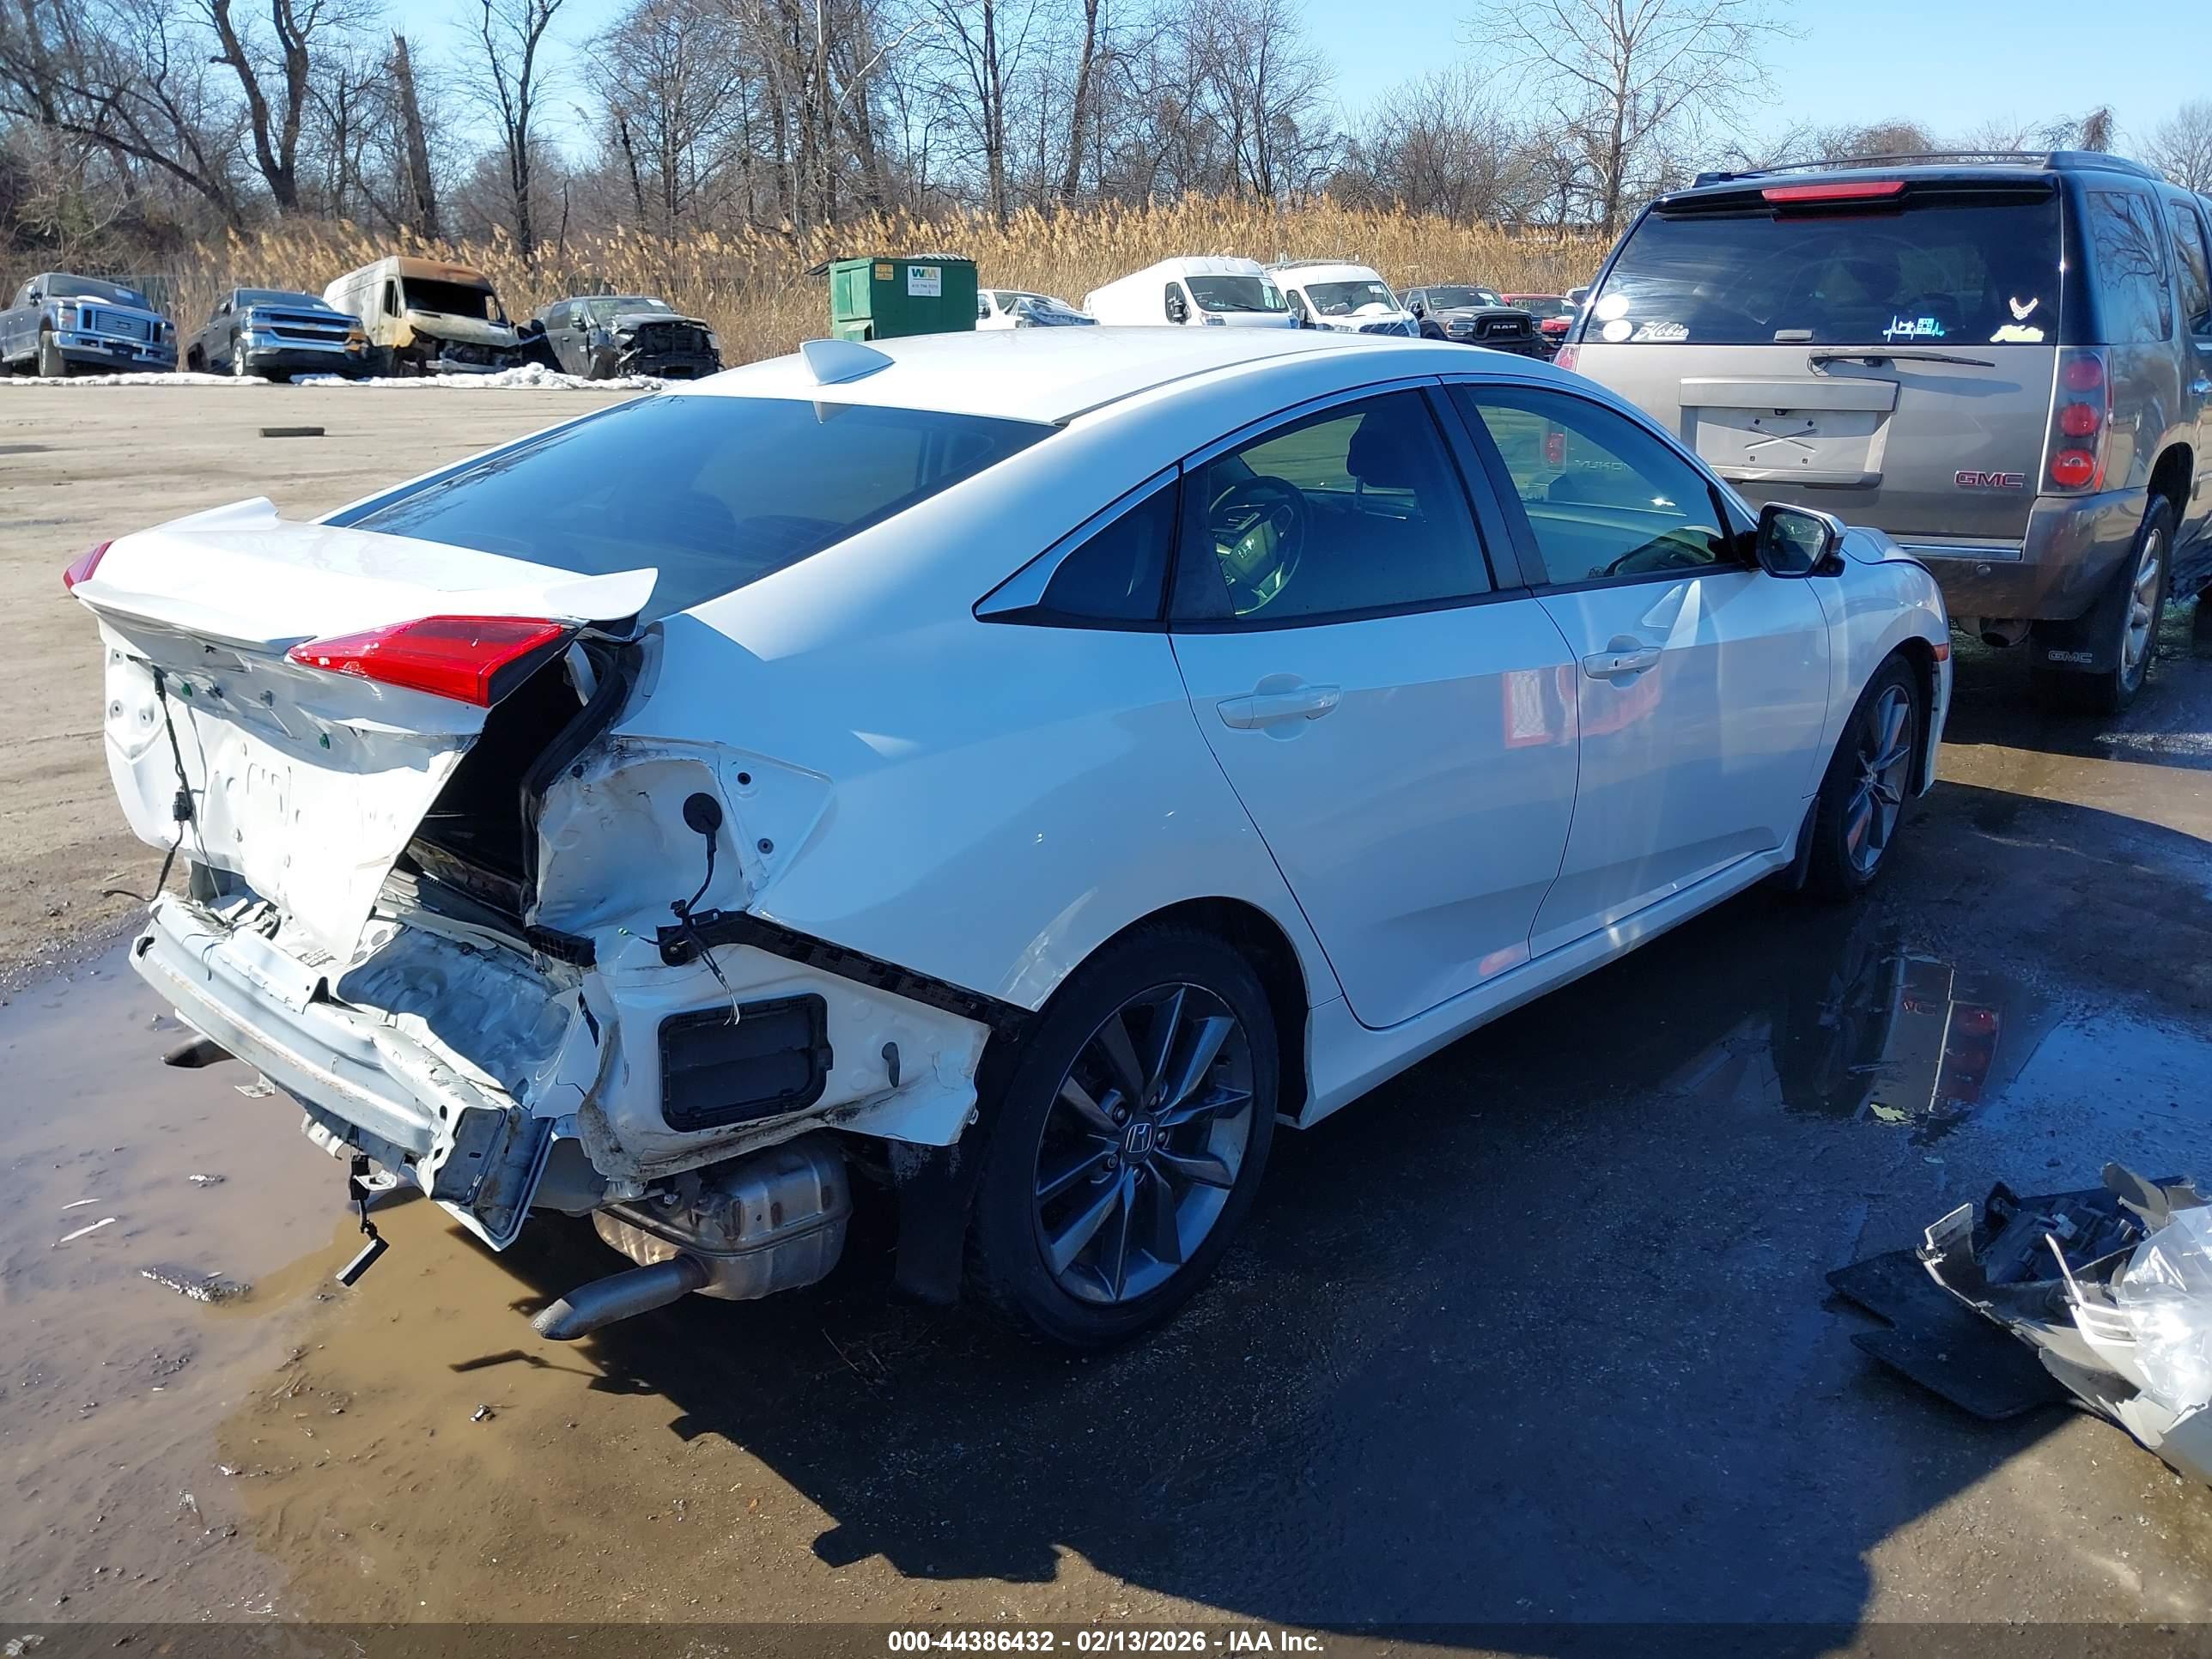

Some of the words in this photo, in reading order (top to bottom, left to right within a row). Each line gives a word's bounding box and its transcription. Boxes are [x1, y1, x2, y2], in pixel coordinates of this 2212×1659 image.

[1631, 321, 1690, 342] Hobie
[1954, 470, 2025, 488] GMC
[2048, 650, 2094, 663] GMC
